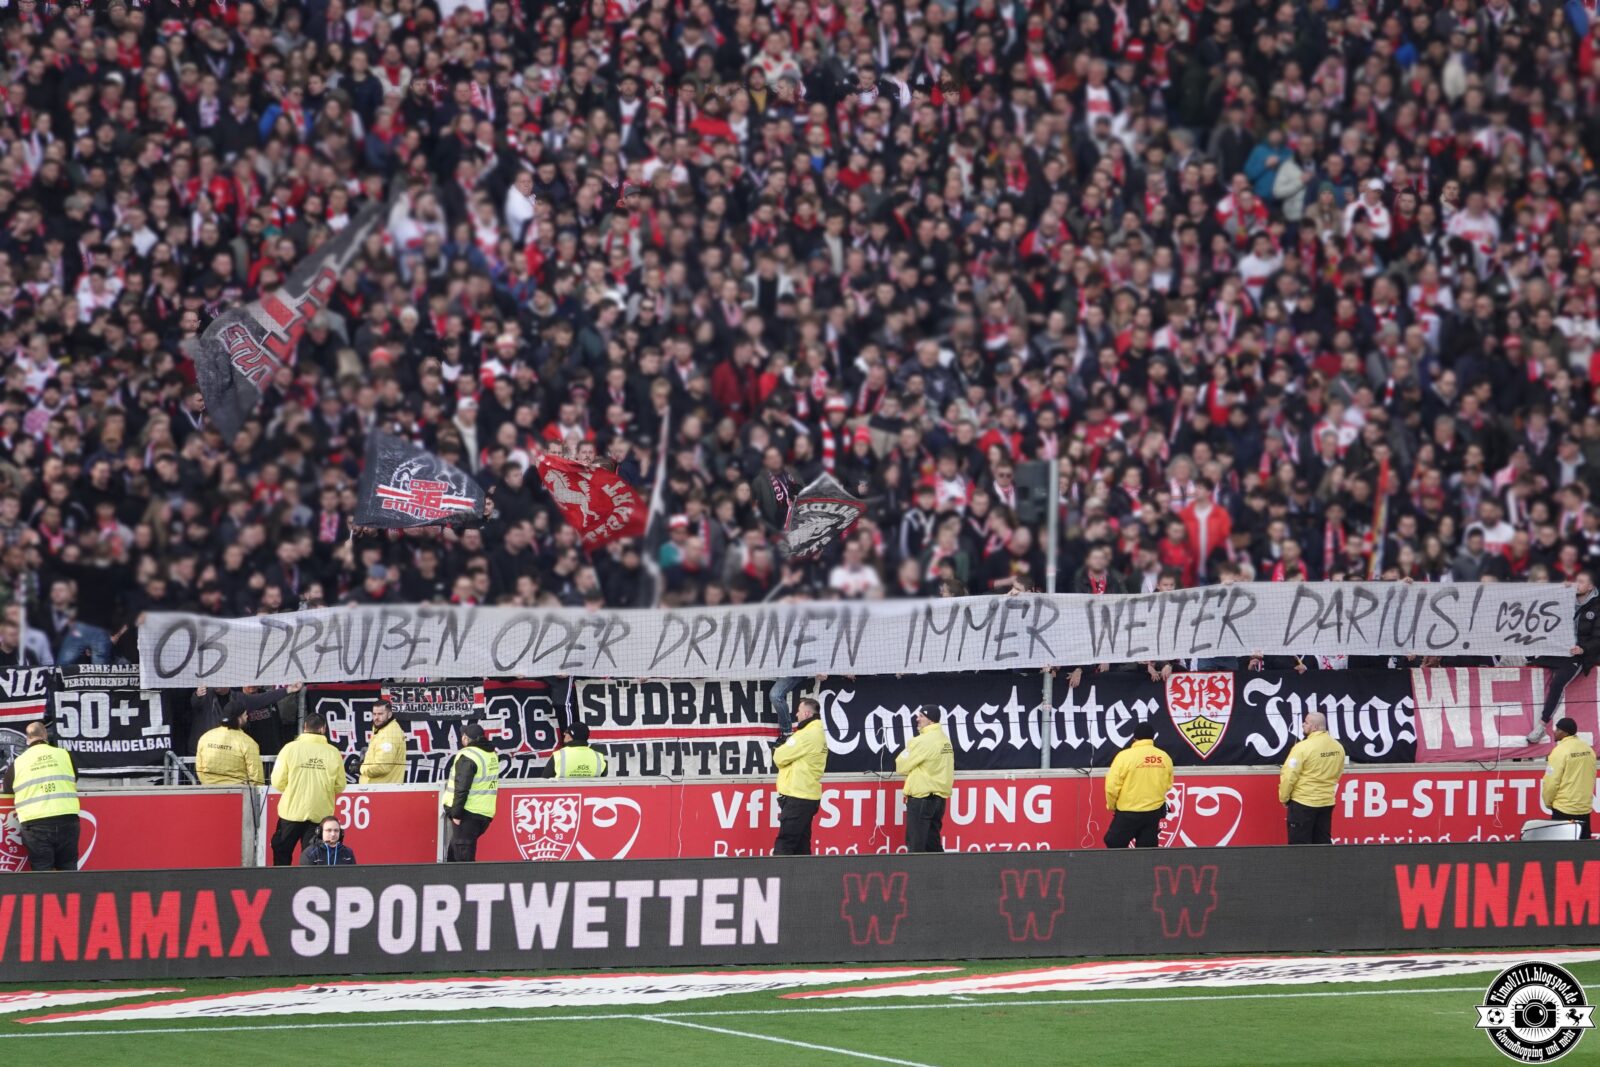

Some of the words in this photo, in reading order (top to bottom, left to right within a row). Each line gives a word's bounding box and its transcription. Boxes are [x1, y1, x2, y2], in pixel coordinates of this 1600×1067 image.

[408, 489, 444, 508] 36
[153, 618, 230, 680] OB
[491, 611, 631, 672] ODER
[648, 606, 870, 671] DRINNEN
[904, 598, 1060, 668] IMMER
[1086, 586, 1257, 659] WEITER
[1282, 584, 1484, 650] DARIUS!
[54, 691, 171, 738] 50+1
[390, 685, 475, 703] SEKTION
[1243, 677, 1417, 757] Jungs
[487, 695, 558, 751] 36
[335, 795, 370, 830] 36
[554, 833, 564, 841] 93
[290, 877, 781, 958] SPORTWETTEN
